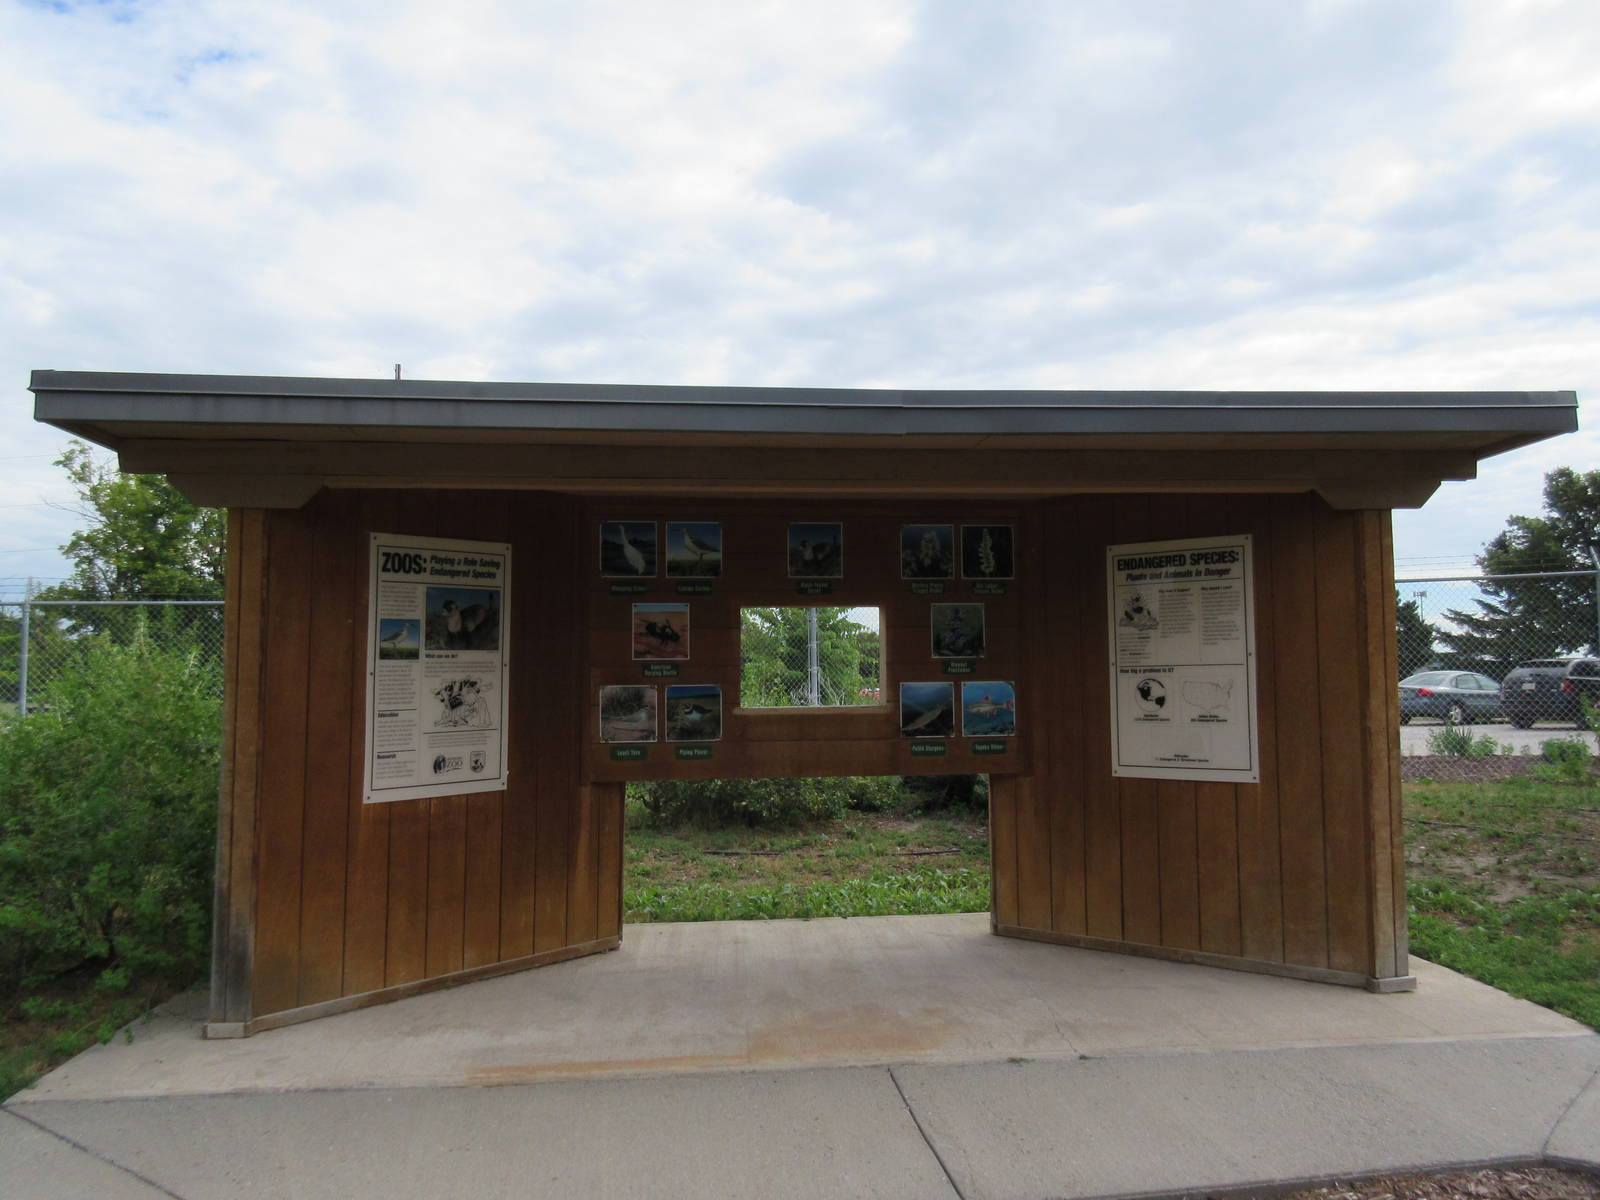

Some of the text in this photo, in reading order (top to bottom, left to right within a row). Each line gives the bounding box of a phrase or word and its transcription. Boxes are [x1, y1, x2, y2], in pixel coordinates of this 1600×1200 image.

[381, 552, 428, 574] ZOOS:
[431, 555, 456, 567] Playing
[463, 557, 478, 567] Role
[479, 558, 501, 570] Saving
[1117, 550, 1240, 571] ENDANGERED SPECIES:
[431, 567, 496, 579] Endangered Species
[1126, 572, 1147, 581] Plants
[1149, 571, 1162, 580] and
[1164, 569, 1193, 579] Animals
[1204, 568, 1232, 578] Danger
